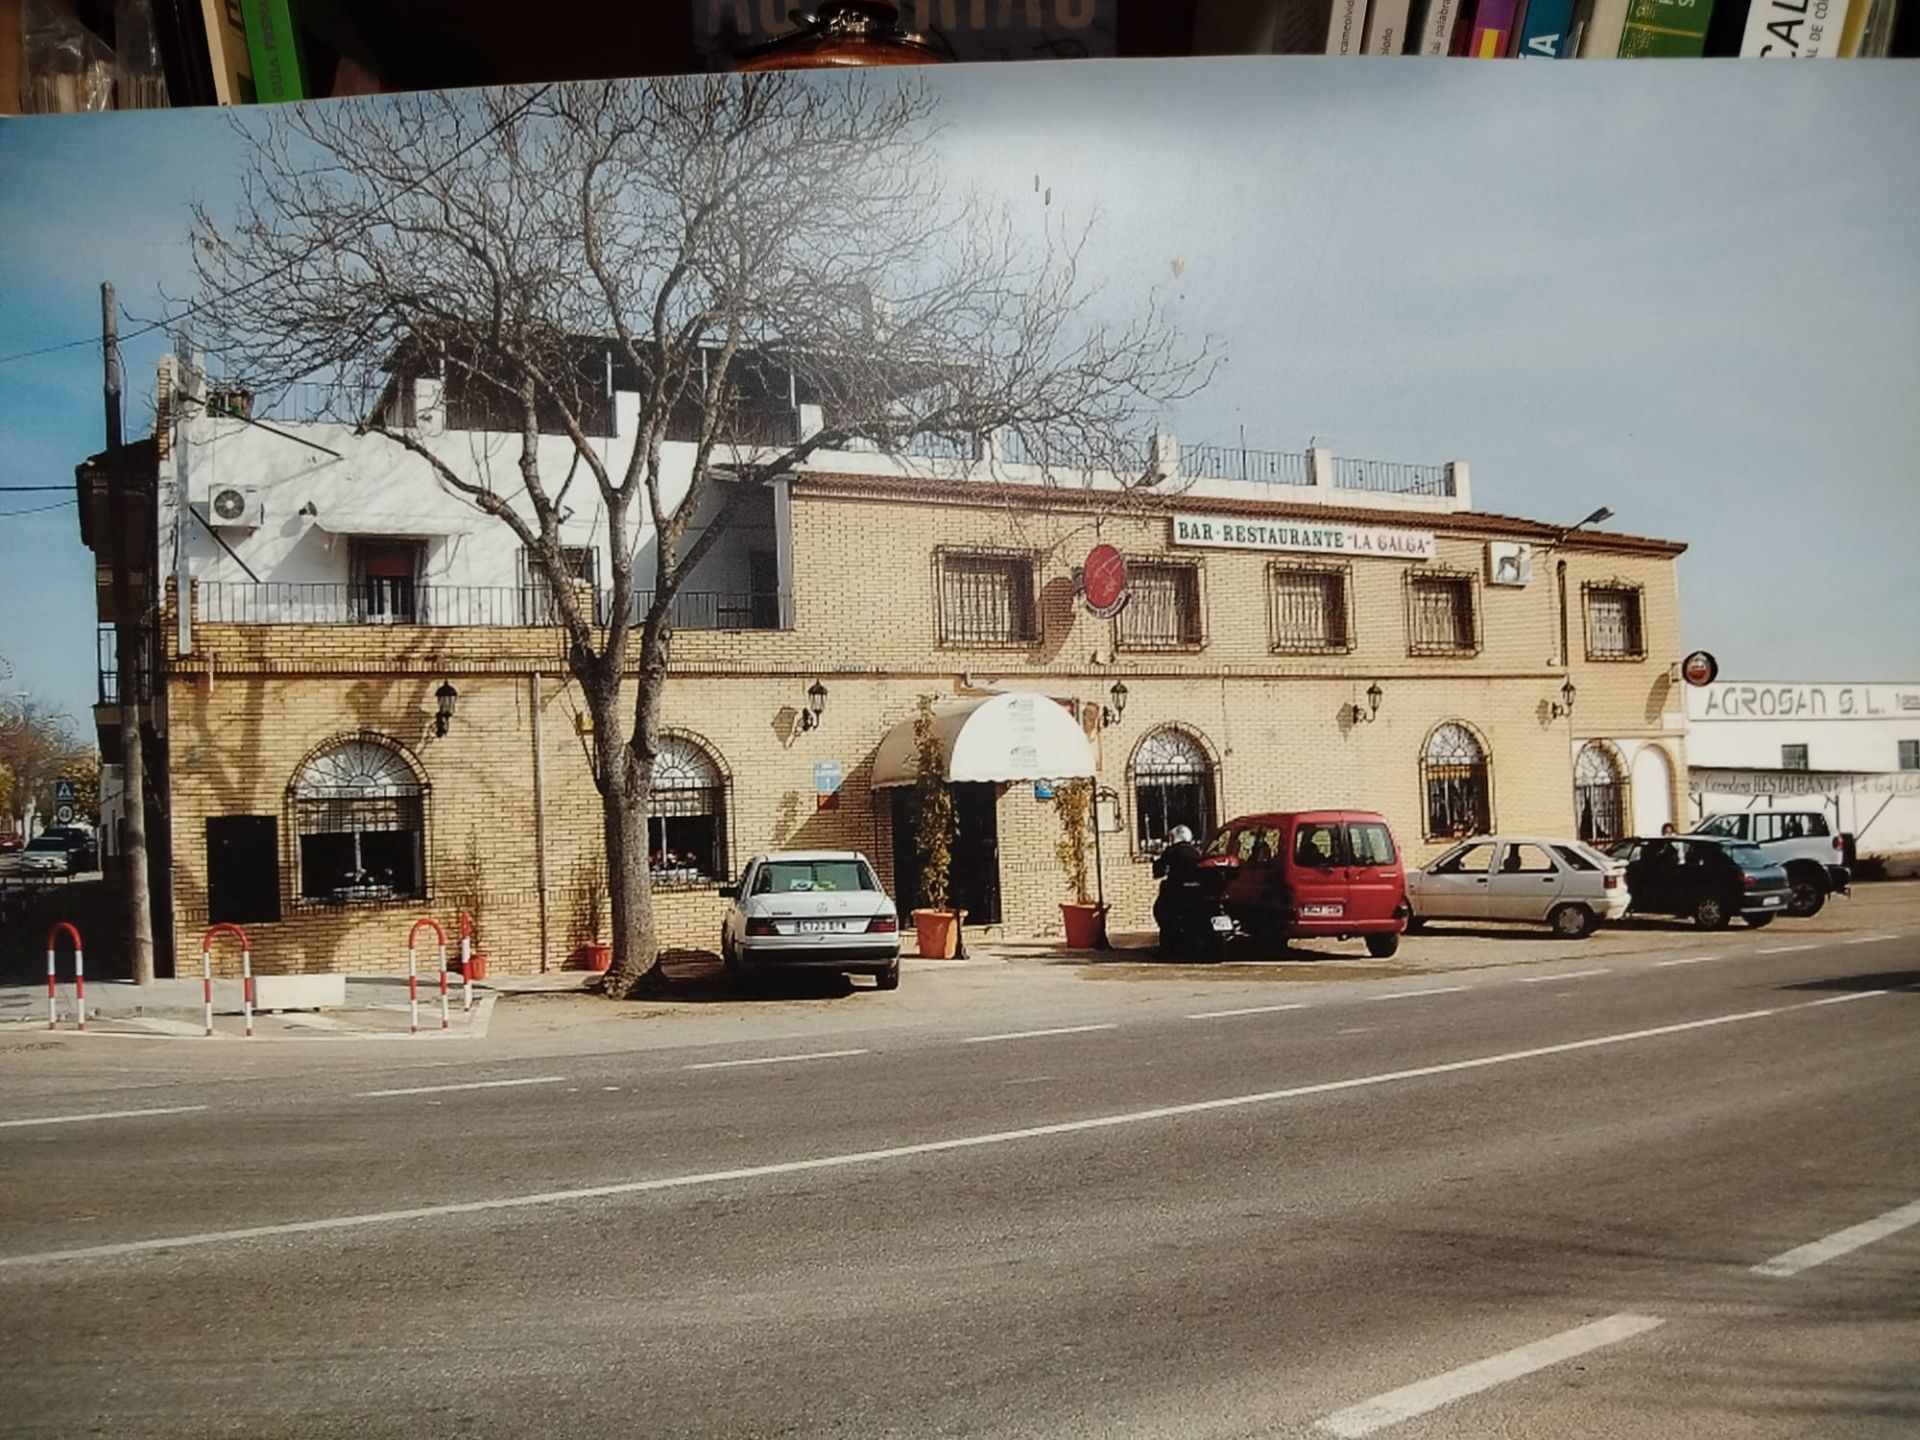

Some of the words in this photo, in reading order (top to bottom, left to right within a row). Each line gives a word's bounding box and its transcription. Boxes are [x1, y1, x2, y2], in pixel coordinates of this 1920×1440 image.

[1814, 0, 1829, 20] CÓ
[1809, 24, 1824, 42] DE
[1705, 687, 1827, 716] AGROSAN
